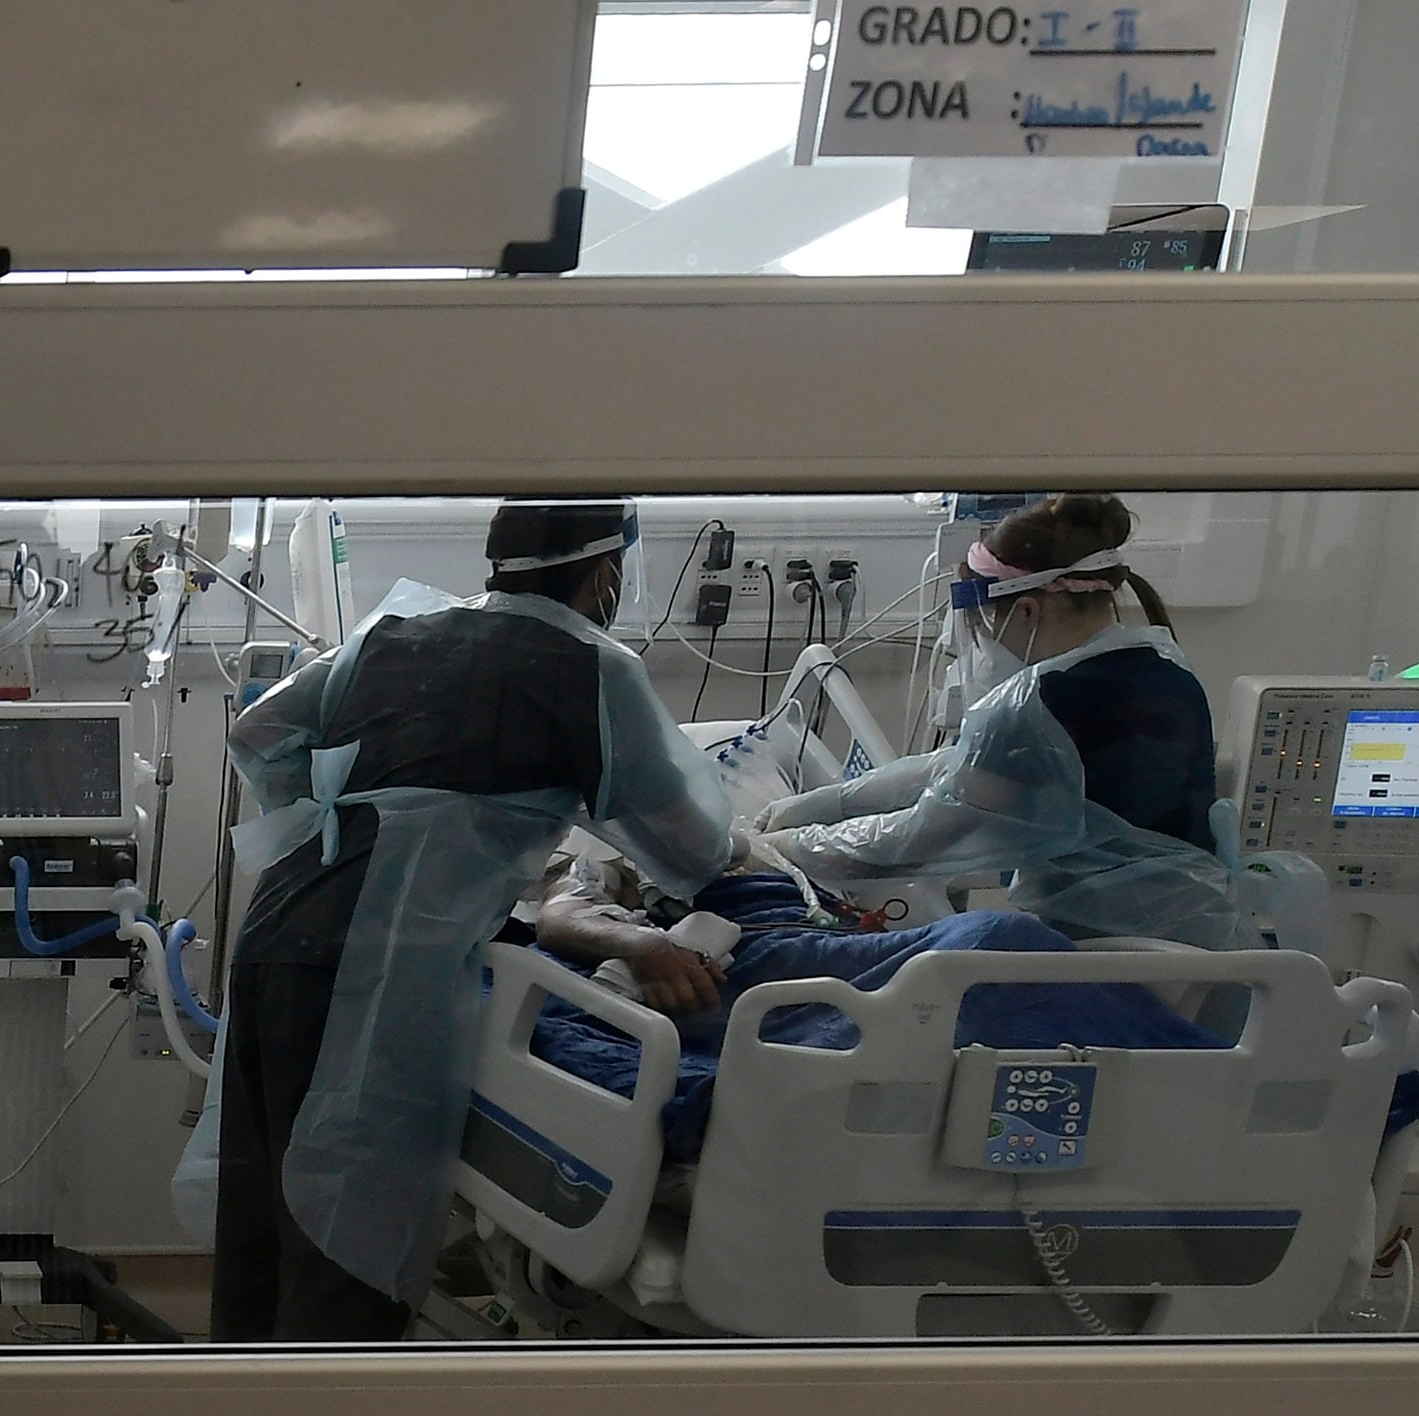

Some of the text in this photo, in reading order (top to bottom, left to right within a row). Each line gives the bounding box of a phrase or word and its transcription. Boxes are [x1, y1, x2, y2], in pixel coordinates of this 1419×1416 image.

[859, 6, 1031, 46] GRADO:
[845, 80, 970, 120] ZONA
[1130, 240, 1188, 257] 87 85
